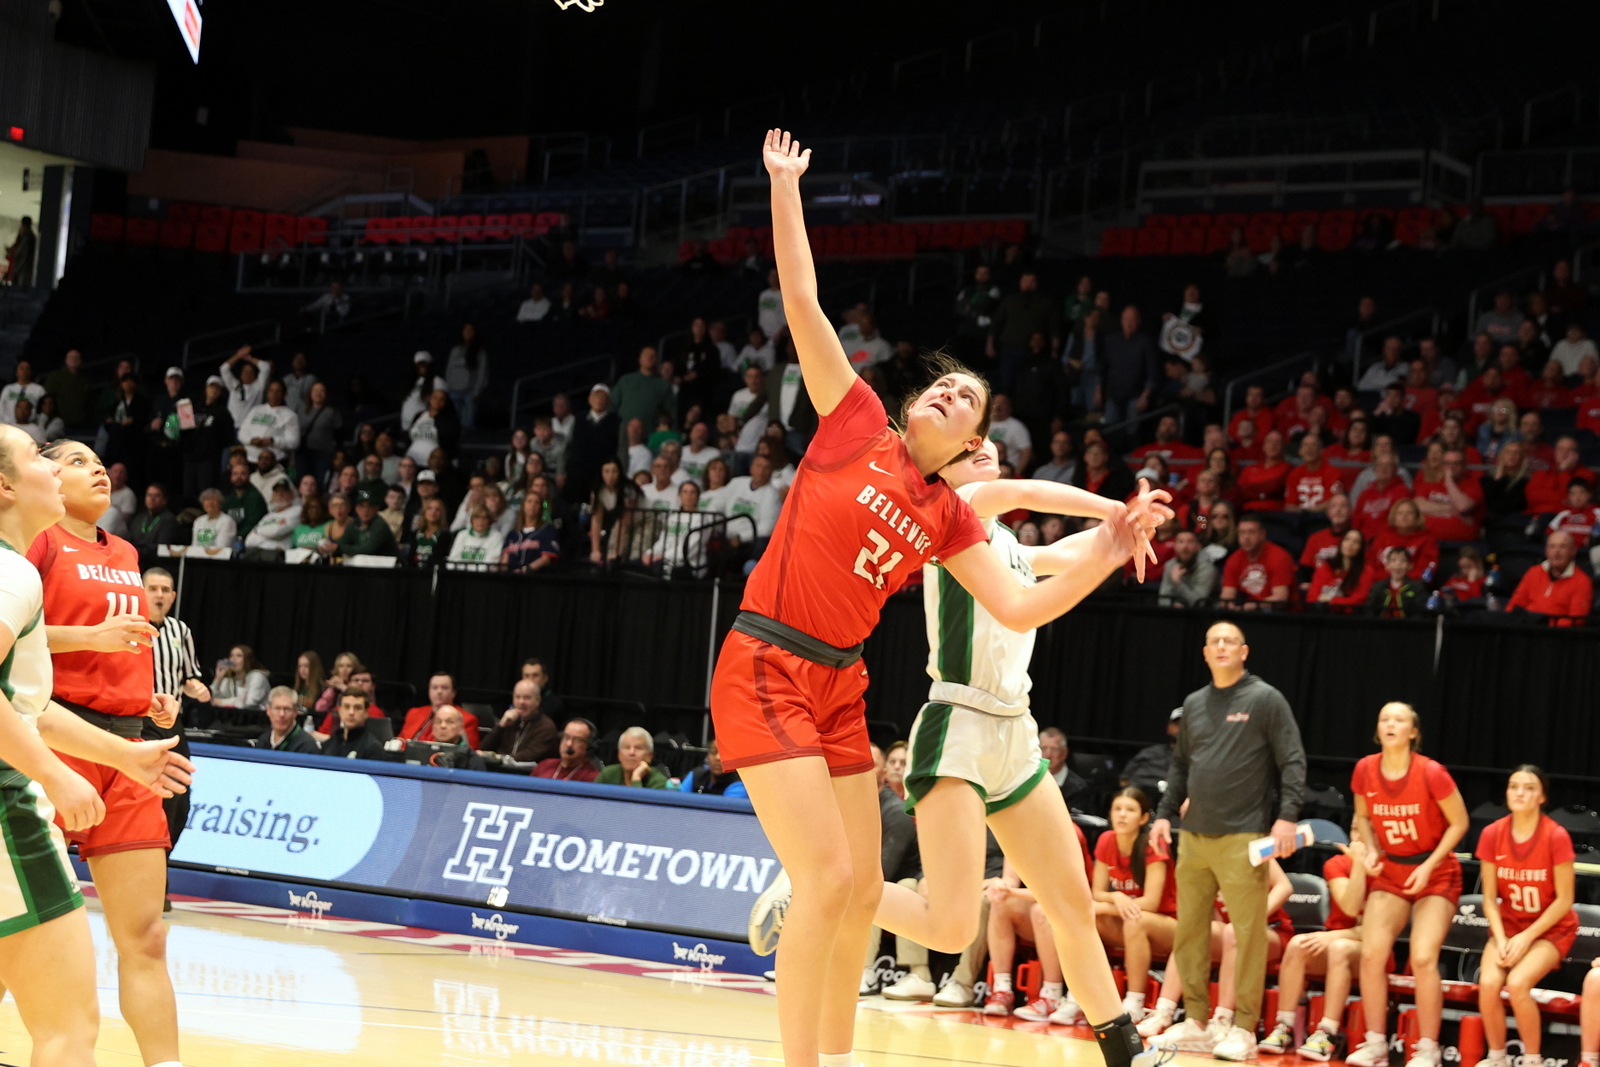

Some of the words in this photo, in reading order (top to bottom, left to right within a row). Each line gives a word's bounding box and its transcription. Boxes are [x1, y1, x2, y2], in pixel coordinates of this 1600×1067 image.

[855, 484, 932, 555] BELLEVUE
[184, 796, 320, 854] raising.
[1382, 818, 1419, 845] 24
[521, 832, 777, 893] HOMETOWN
[1508, 883, 1541, 913] 20
[484, 913, 520, 940] Kroger
[687, 943, 726, 970] Kroger
